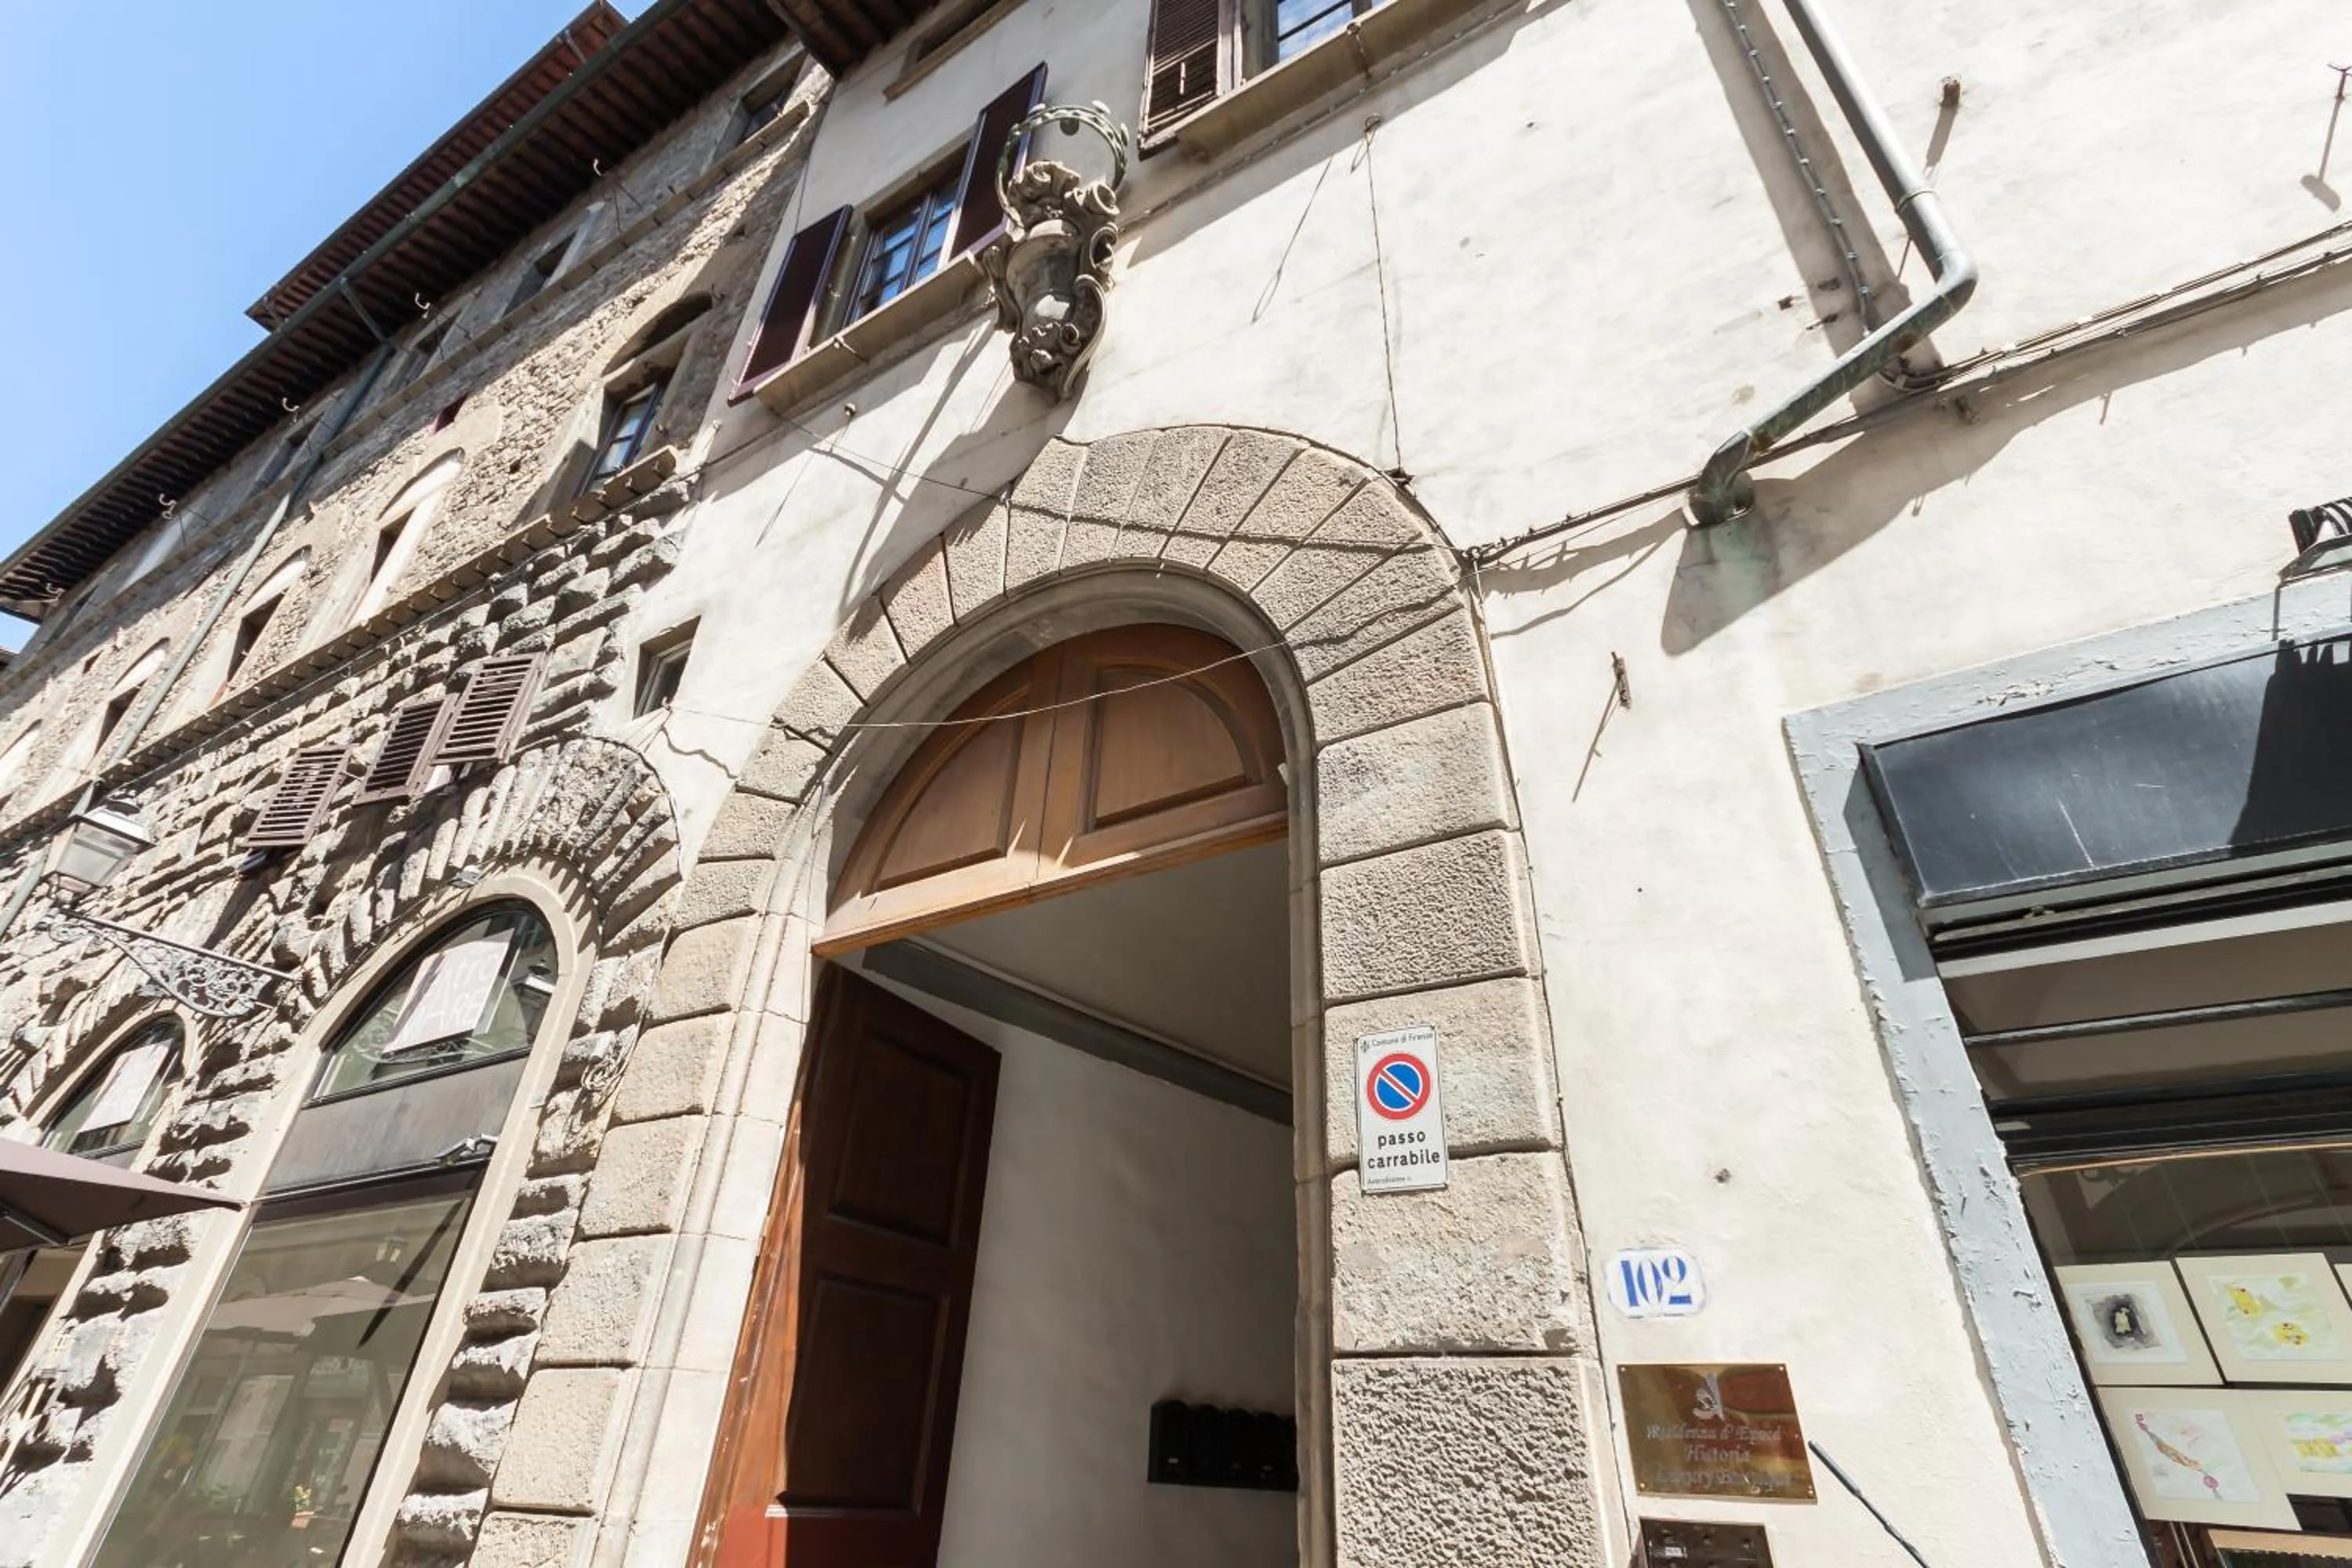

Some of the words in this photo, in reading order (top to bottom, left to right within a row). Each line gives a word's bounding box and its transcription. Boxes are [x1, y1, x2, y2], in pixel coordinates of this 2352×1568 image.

[1377, 1131, 1426, 1149] passo
[1367, 1149, 1440, 1169] carrabile
[1621, 1256, 1693, 1307] 102
